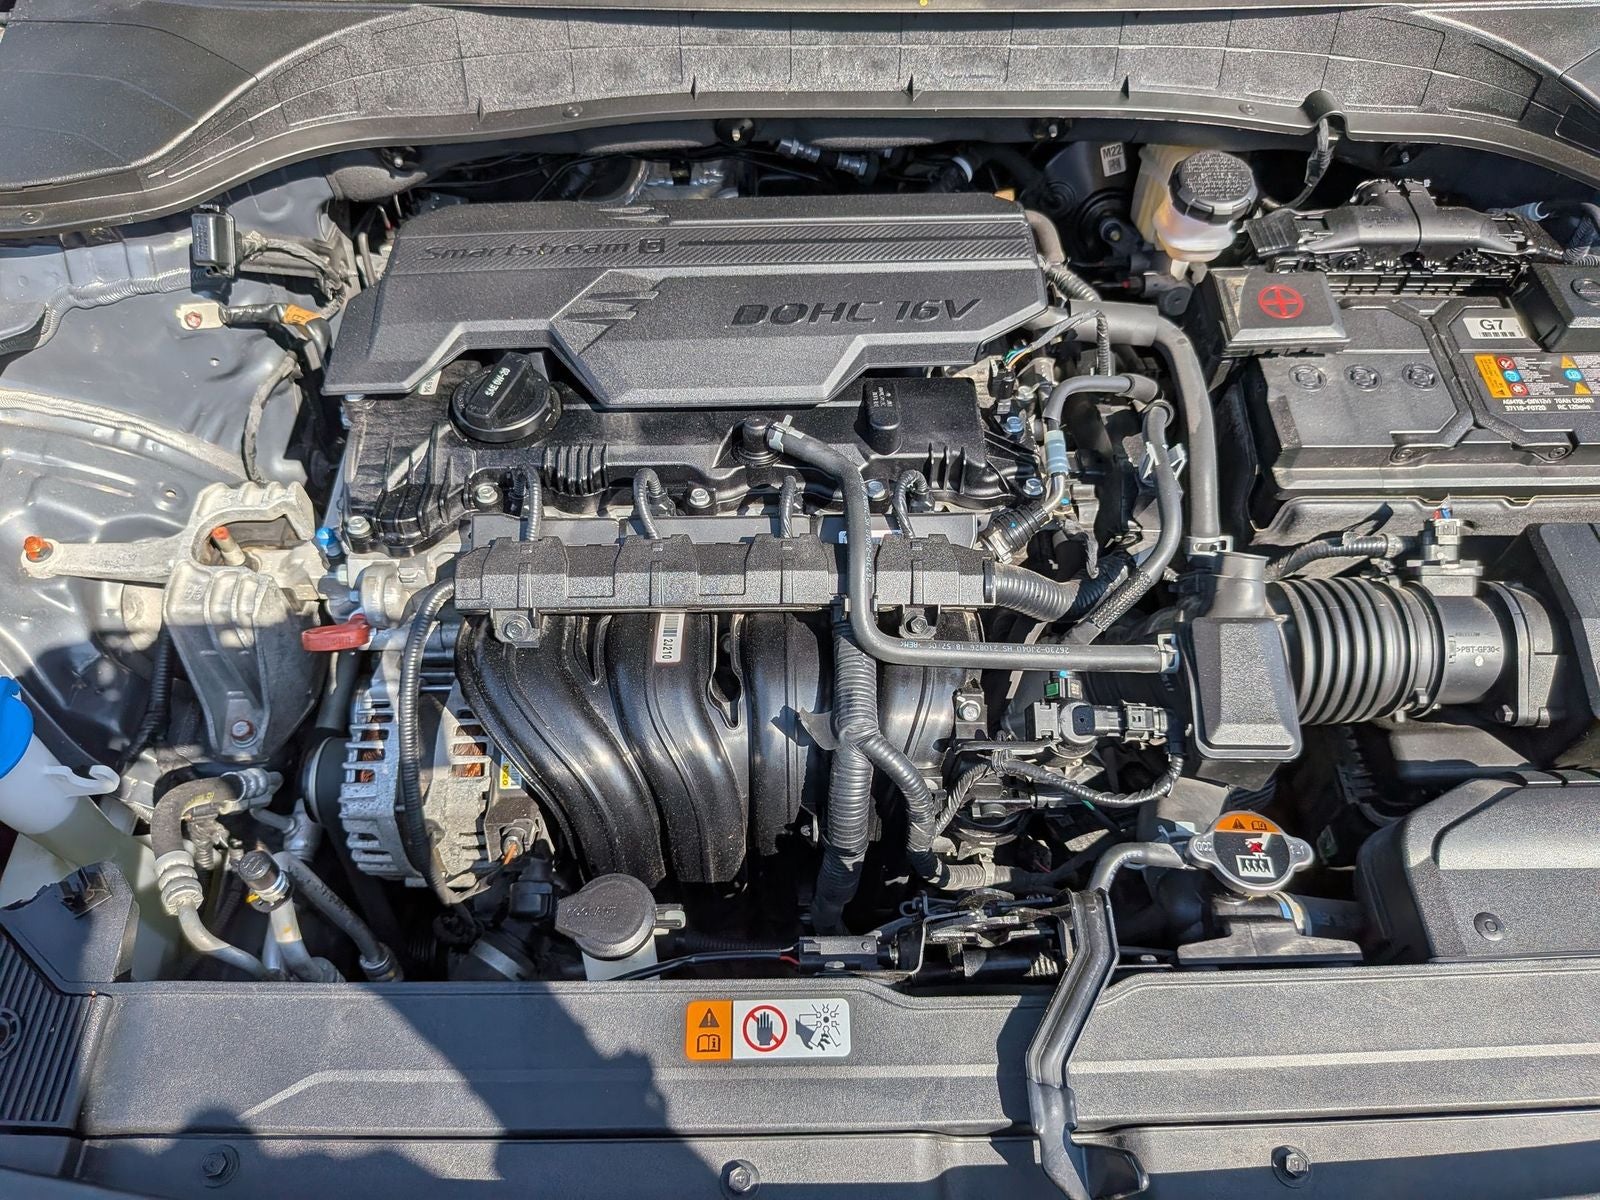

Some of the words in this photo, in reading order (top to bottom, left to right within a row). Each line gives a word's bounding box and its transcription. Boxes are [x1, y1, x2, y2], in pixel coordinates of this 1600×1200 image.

[1103, 144, 1123, 160] M22
[415, 242, 631, 260] Smartstream
[731, 300, 884, 326] DOHC
[896, 298, 982, 322] 16V
[1480, 319, 1503, 330] G7
[484, 381, 499, 397] SAE
[662, 638, 673, 660] 2J210
